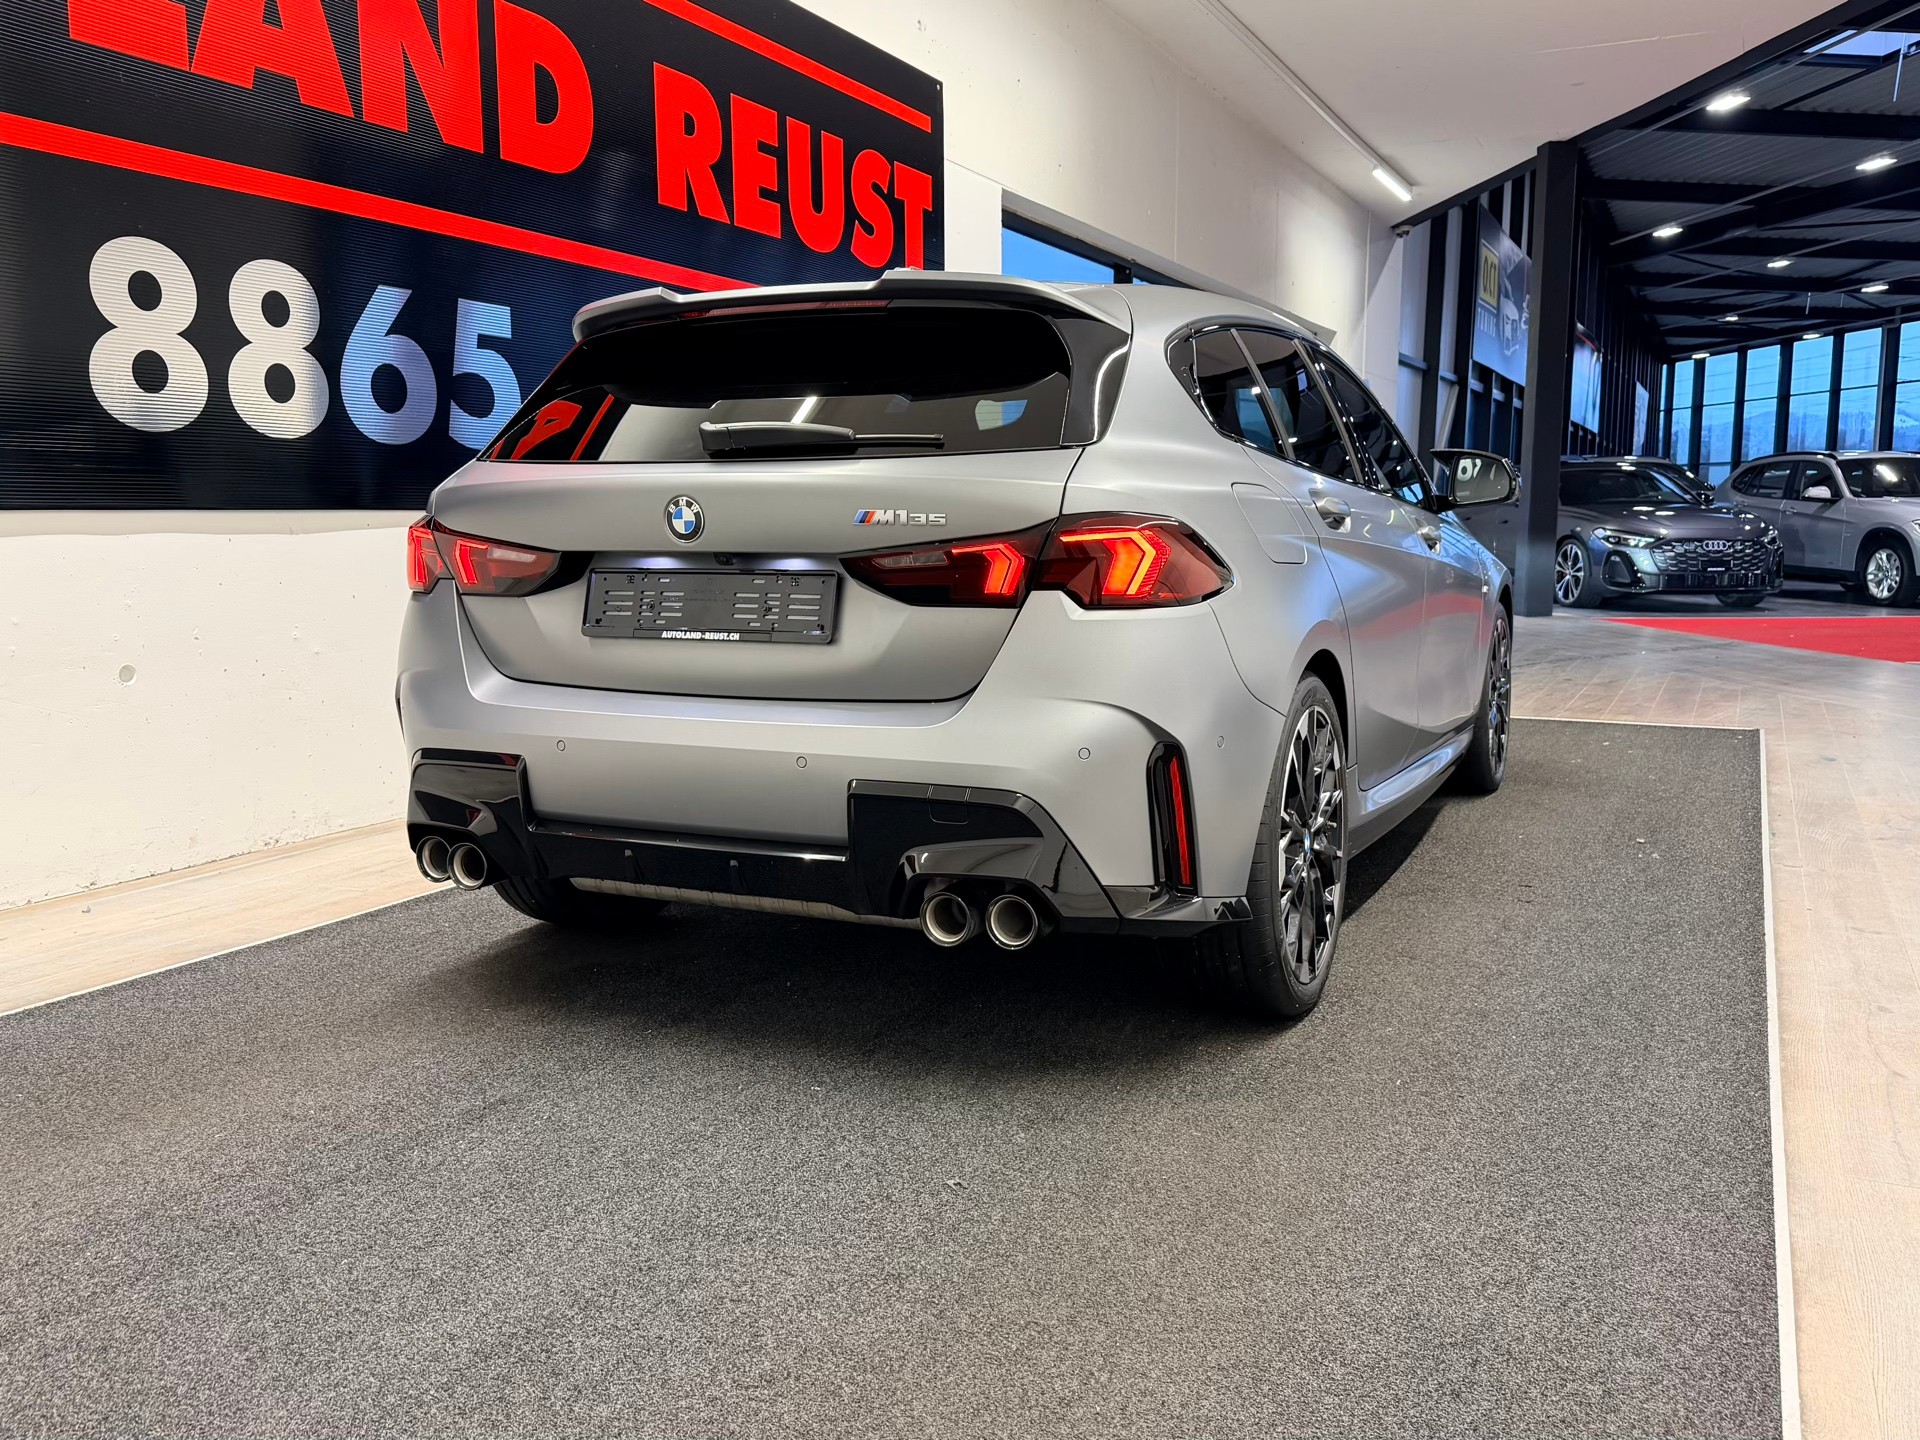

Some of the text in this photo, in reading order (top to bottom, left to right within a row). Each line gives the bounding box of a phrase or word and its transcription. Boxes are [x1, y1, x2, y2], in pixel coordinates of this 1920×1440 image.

[68, 0, 932, 270] AND REUST
[88, 236, 522, 450] 8865
[668, 498, 701, 513] BMW
[871, 509, 947, 526] M135
[661, 630, 740, 641] AUTOLAND-REUST.CH
